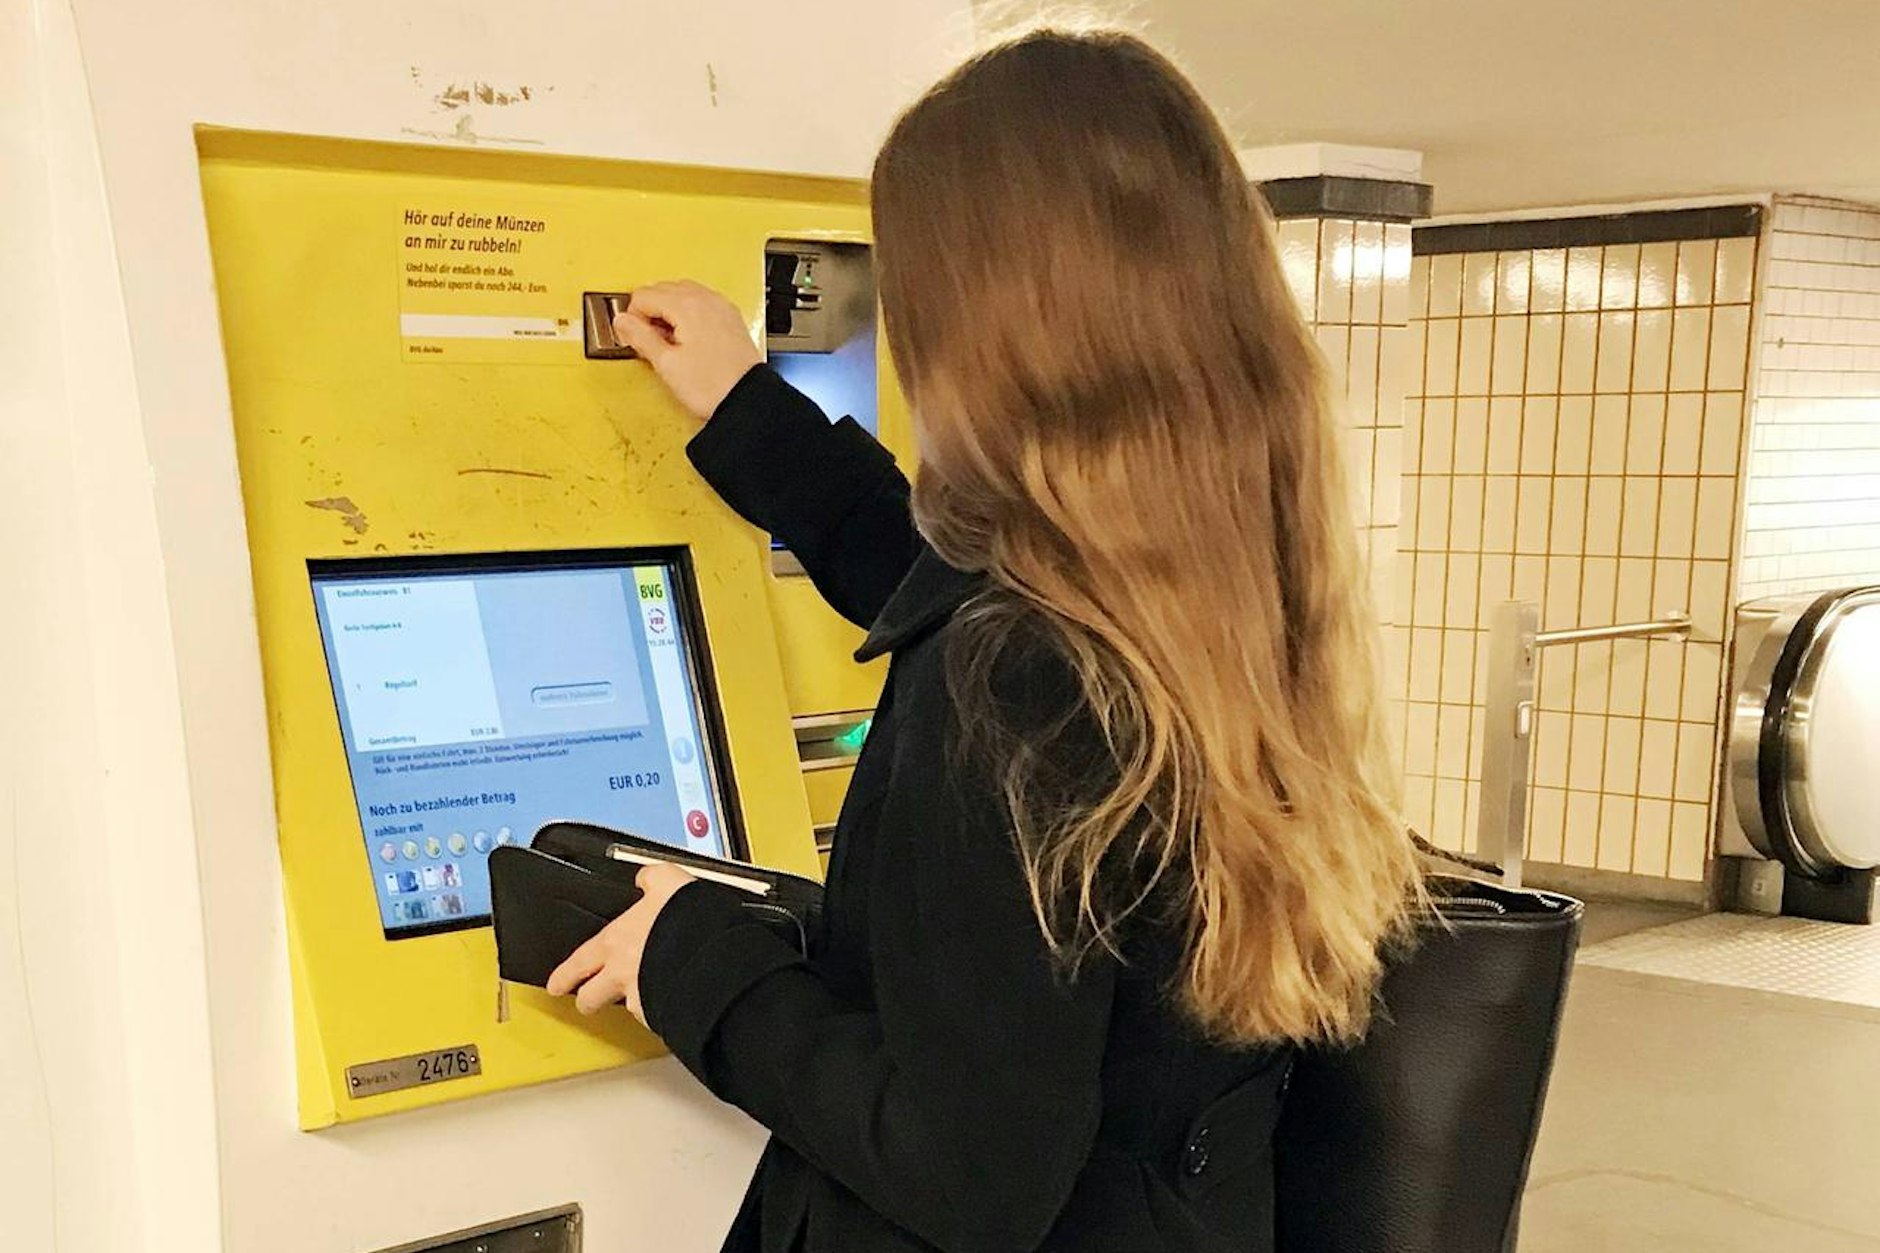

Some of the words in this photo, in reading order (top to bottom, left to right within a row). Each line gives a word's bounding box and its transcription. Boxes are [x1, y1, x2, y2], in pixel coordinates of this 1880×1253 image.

[404, 209, 428, 225] Hör
[431, 211, 455, 227] auf
[457, 212, 493, 229] deine
[495, 215, 546, 233] Münzen
[405, 236, 421, 249] an
[425, 233, 447, 250] mir
[450, 238, 465, 251] zu
[468, 236, 522, 254] rubbeln!
[406, 263, 423, 273] Und
[424, 263, 438, 273] hol
[439, 264, 450, 274] dir
[452, 264, 482, 275] endlich
[483, 266, 496, 276] ein
[407, 278, 446, 289] Nebenbei
[447, 280, 473, 291] sparst
[474, 281, 485, 291] du
[640, 584, 663, 599] BVG
[609, 775, 633, 790] EUR
[635, 772, 660, 789] 0,20
[369, 803, 398, 817] Noch
[400, 803, 413, 814] zu
[414, 795, 480, 813] bezahlender
[481, 791, 517, 805] Betrag
[374, 824, 407, 837] zahlbar
[409, 823, 424, 833] mit
[417, 1051, 469, 1082] 2476
